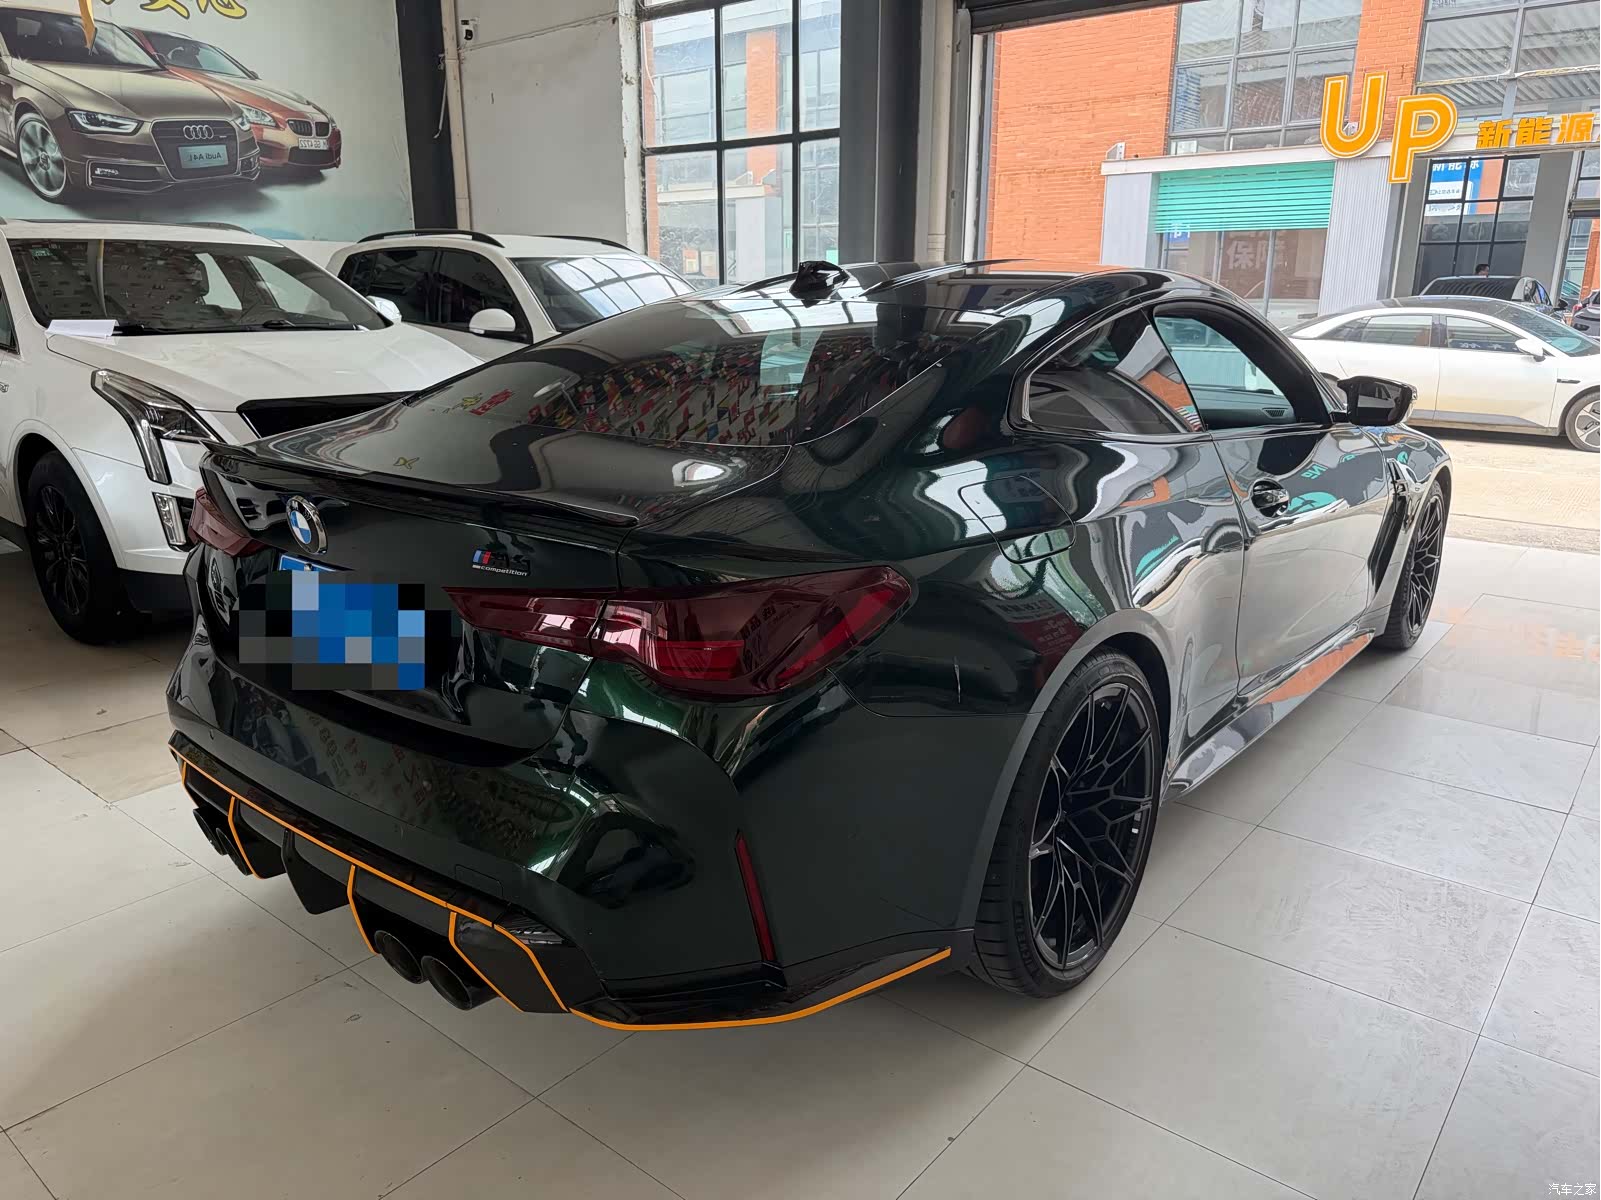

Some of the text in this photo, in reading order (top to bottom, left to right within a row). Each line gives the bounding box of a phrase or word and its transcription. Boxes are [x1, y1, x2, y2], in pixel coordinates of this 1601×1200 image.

[1319, 70, 1600, 184] UP 新能源
